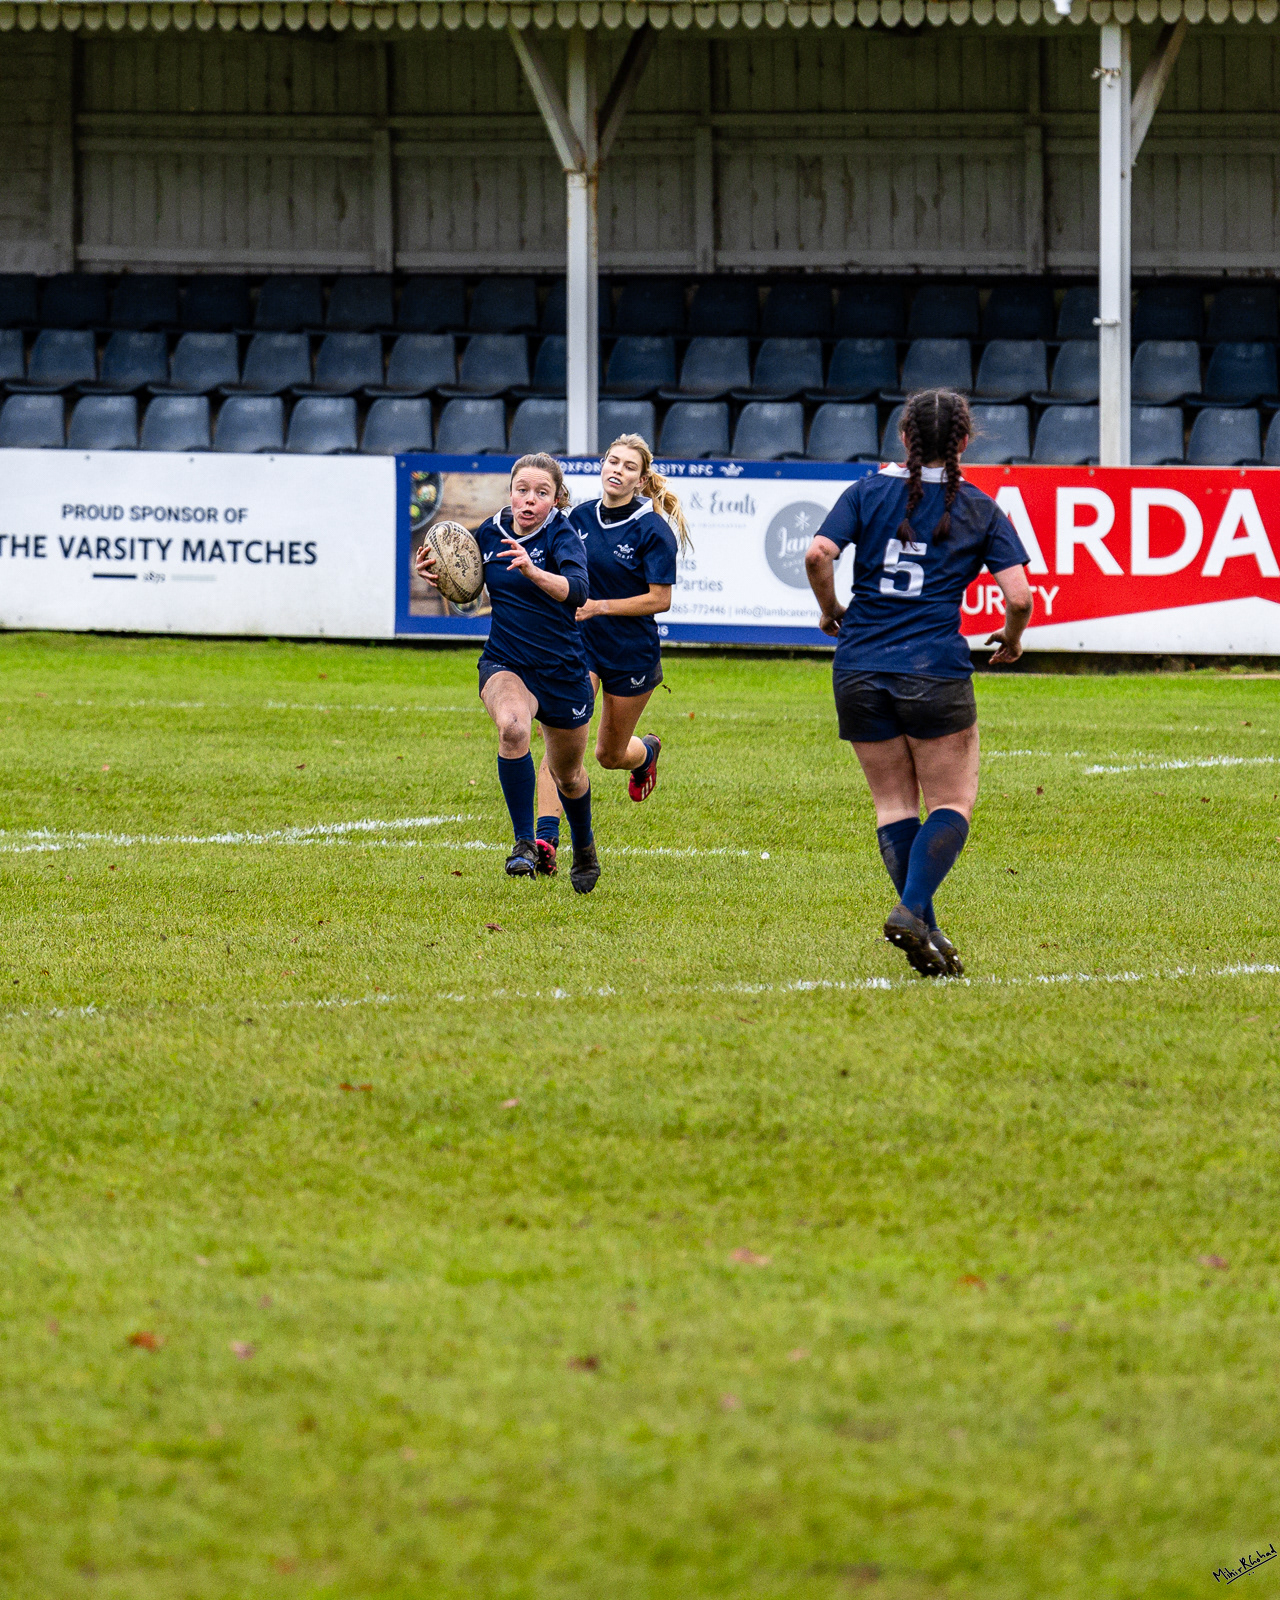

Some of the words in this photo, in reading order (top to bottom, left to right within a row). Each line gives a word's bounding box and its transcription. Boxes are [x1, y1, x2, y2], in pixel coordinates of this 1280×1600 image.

[560, 462, 601, 474] OXFOR
[688, 463, 714, 476] RFC
[61, 503, 124, 521] PROUD
[130, 505, 218, 523] SPONSOR
[223, 507, 248, 523] OF
[690, 491, 704, 509] &
[709, 490, 757, 516] Events
[980, 486, 1280, 578] ARDA
[0, 534, 47, 559] THE
[58, 536, 173, 561] VARSITY
[182, 538, 318, 565] MATCHES
[879, 538, 927, 597] 5
[674, 574, 724, 592] Parties
[671, 603, 726, 616] 865-772446
